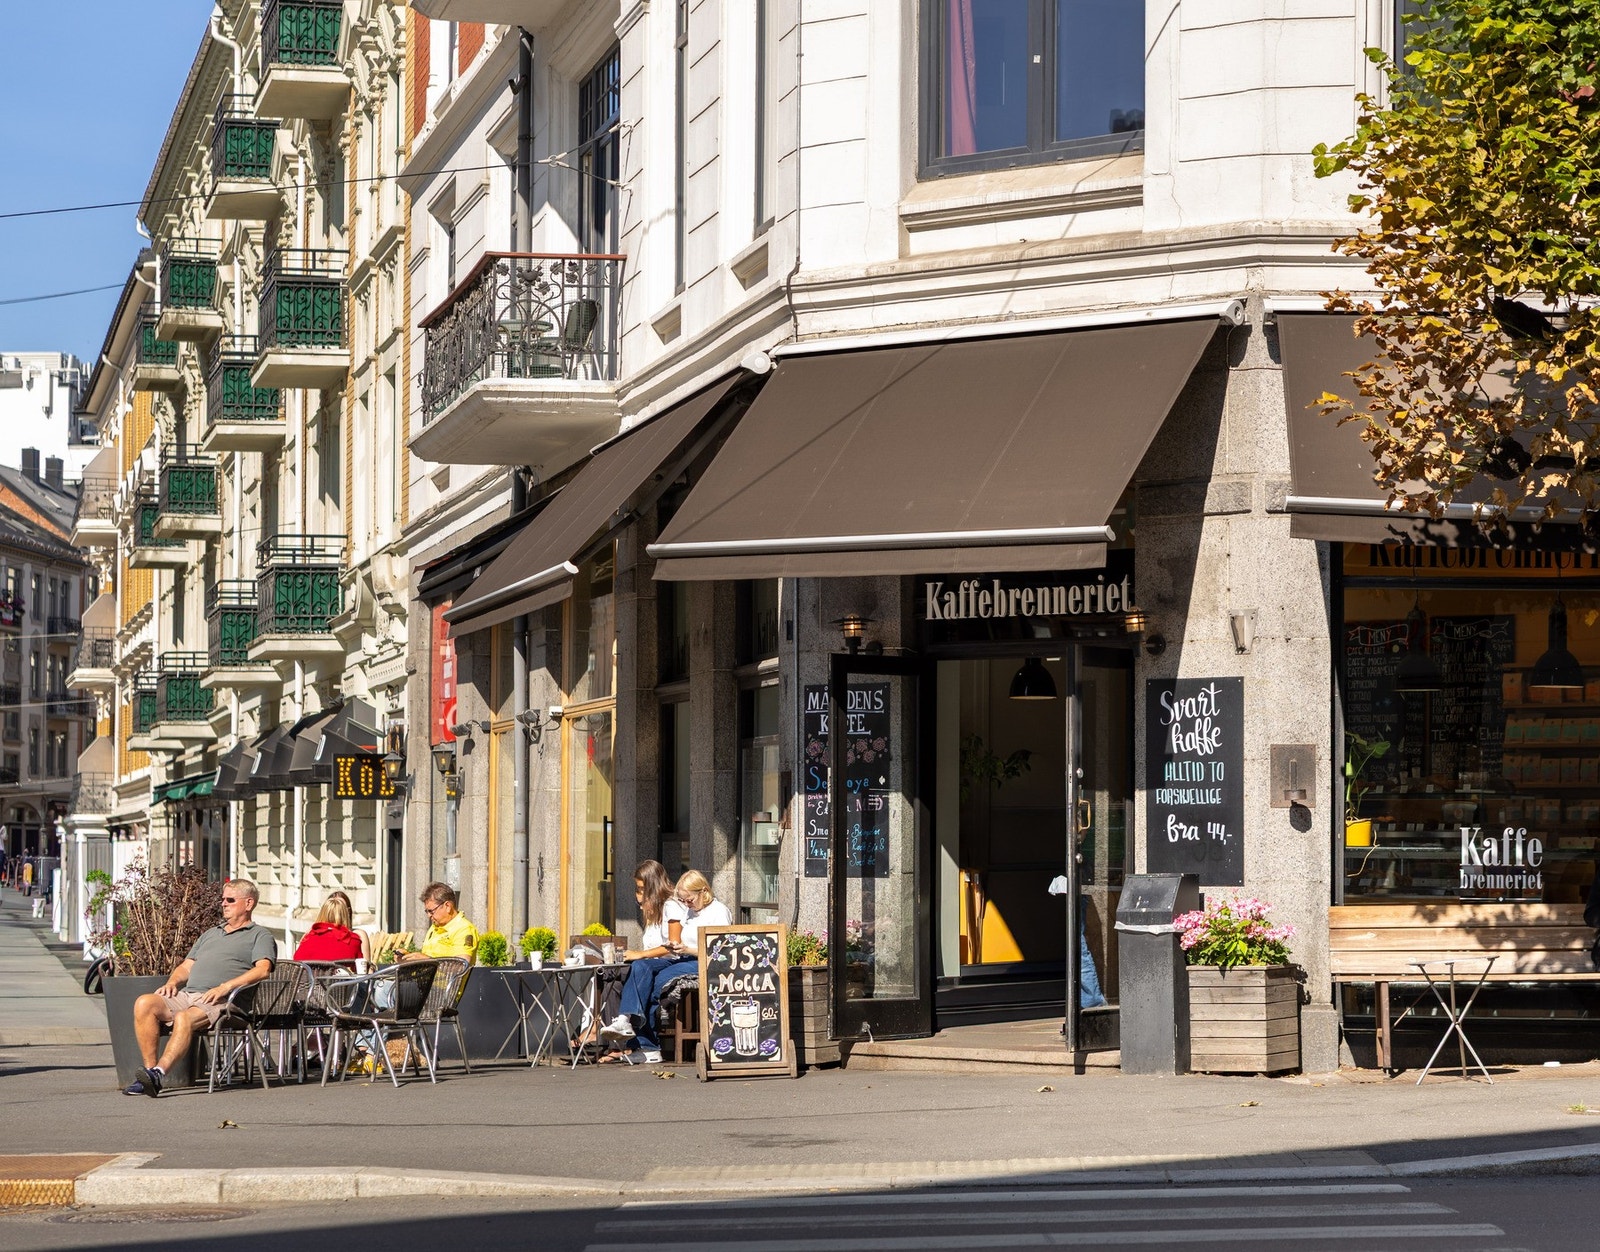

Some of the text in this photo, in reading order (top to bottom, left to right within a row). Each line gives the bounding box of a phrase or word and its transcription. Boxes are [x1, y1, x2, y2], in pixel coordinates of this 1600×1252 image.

[925, 574, 1131, 621] Kaffebrenneriet
[1453, 624, 1477, 637] MENY
[806, 685, 884, 711] MÅDENS
[1160, 682, 1222, 725] Svart
[820, 713, 865, 733] KFE
[1172, 717, 1222, 756] kaffe
[1165, 761, 1225, 782] ALLTID TO
[1156, 788, 1222, 805] FORSKJELLIGE
[1459, 827, 1543, 867] Kaffe
[1459, 869, 1543, 889] brenneriet
